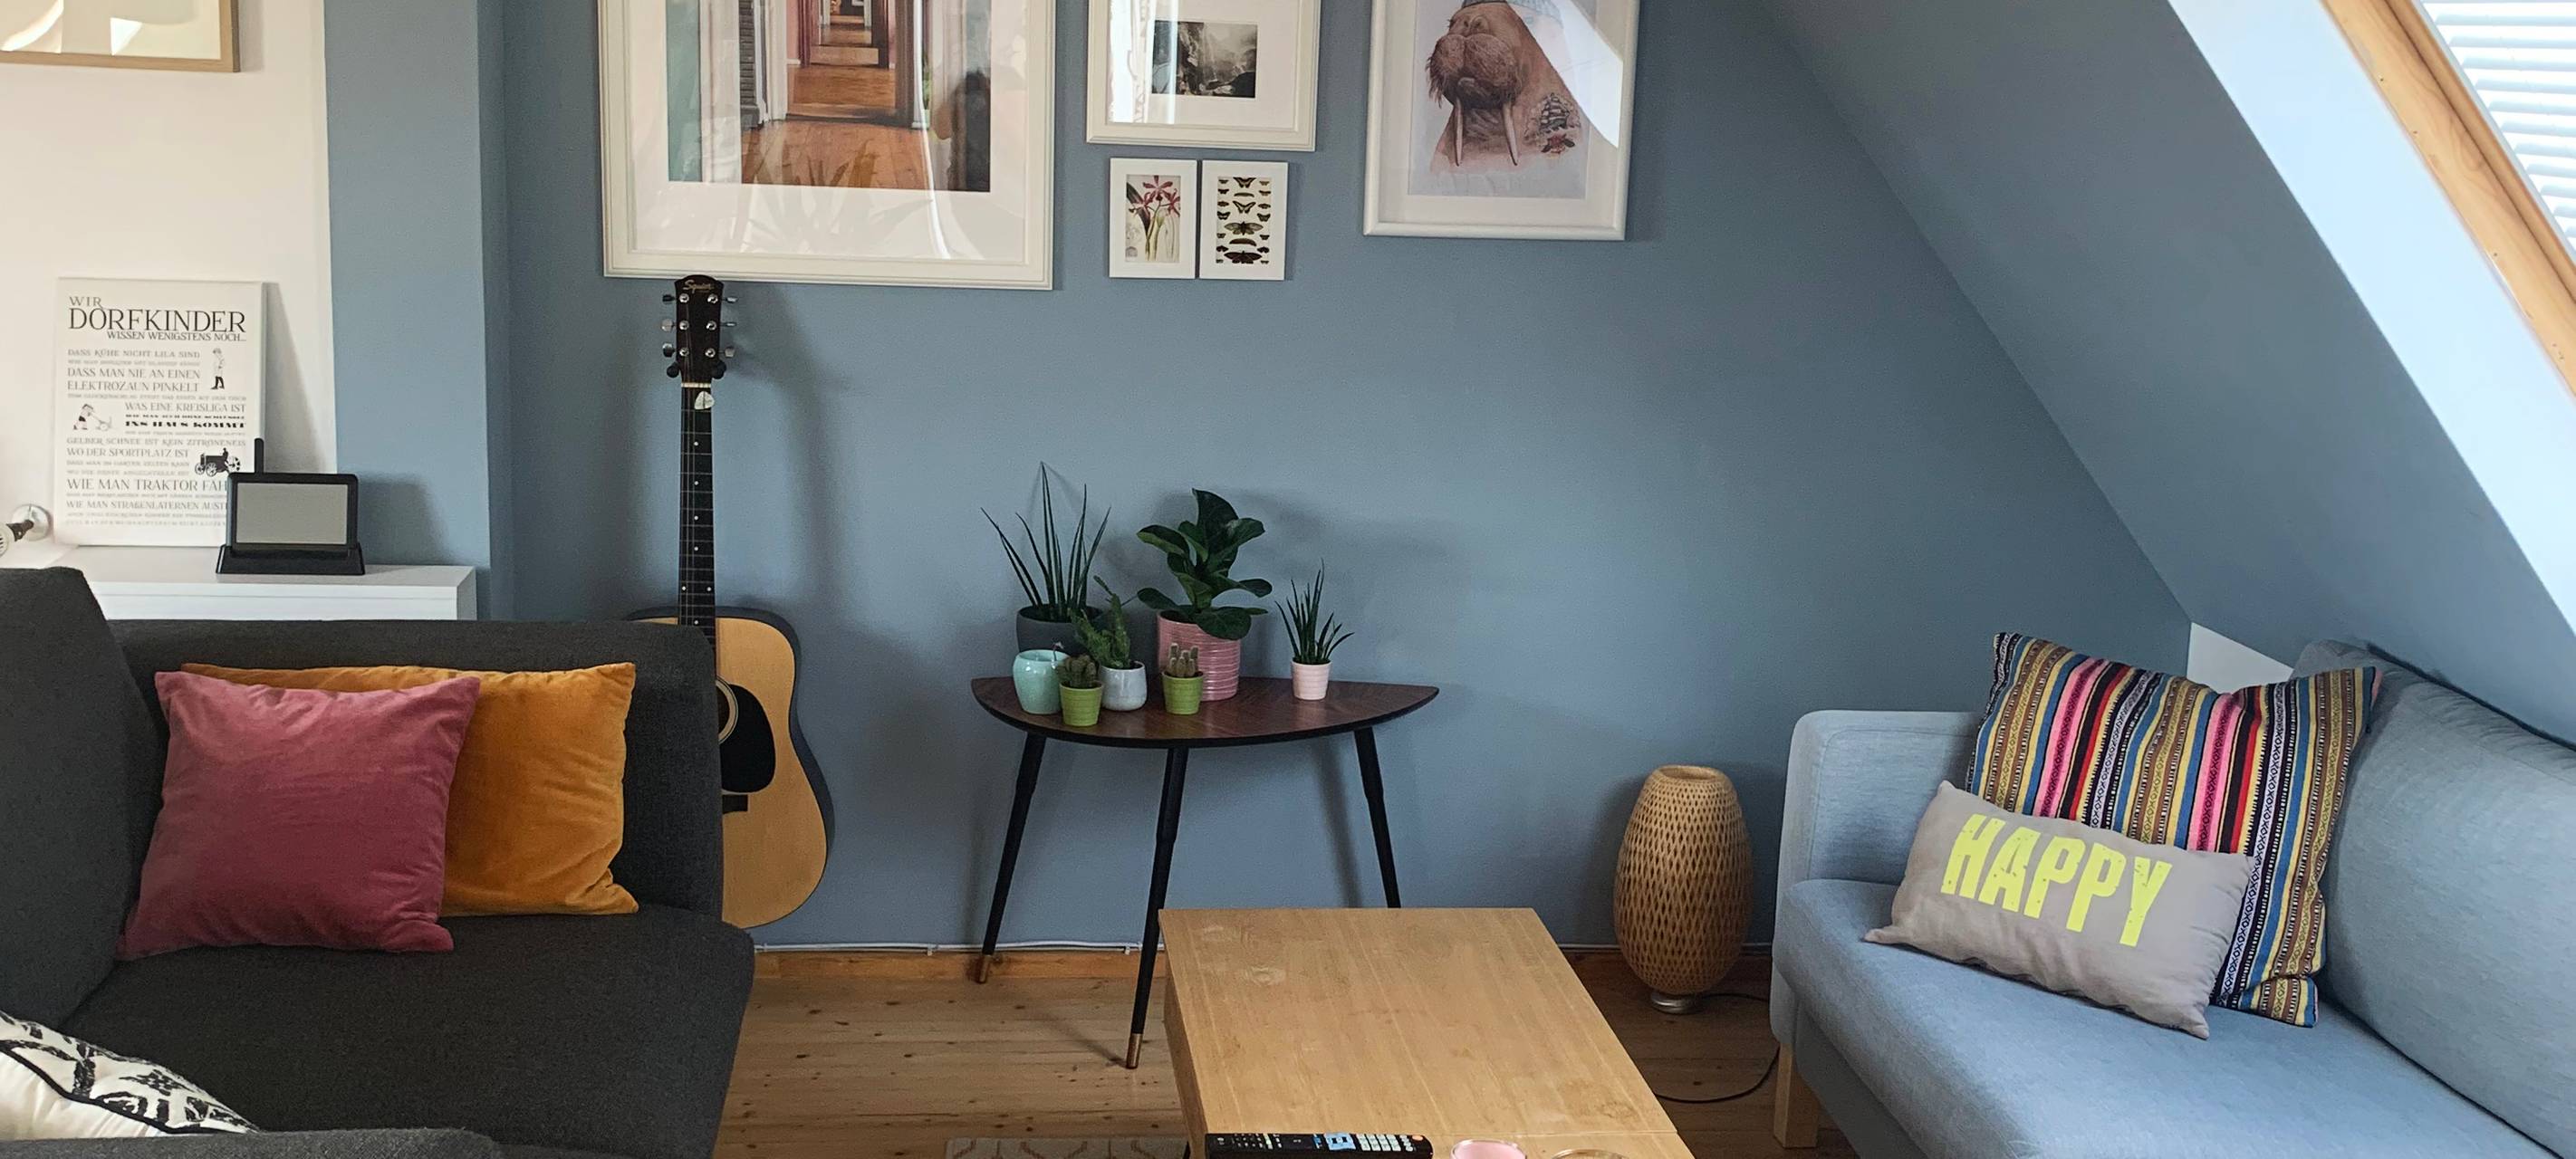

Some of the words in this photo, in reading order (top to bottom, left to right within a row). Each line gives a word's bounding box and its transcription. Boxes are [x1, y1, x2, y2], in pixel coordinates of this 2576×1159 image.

[682, 279, 715, 294] Squier
[69, 296, 103, 308] WIR
[68, 308, 246, 332] DORFKINDER
[107, 331, 145, 340] WISSEN
[148, 331, 211, 341] WENIGSTENS
[67, 368, 96, 377] DASS
[99, 368, 125, 377] MAN
[128, 369, 147, 378] NIE
[149, 369, 165, 378] AN
[168, 369, 200, 378] EINEN
[67, 380, 149, 391] ELEKTROZAUN
[152, 382, 199, 392] PINKELT
[124, 402, 148, 410] WAS
[150, 402, 171, 411] EINE
[176, 403, 228, 412] KREISLIGA
[231, 404, 247, 412] IST
[66, 447, 84, 455] WO
[86, 448, 106, 456] DER
[109, 448, 172, 457] SPORTPLATZ
[175, 449, 188, 457] IST
[66, 478, 94, 490] WIE
[99, 478, 130, 490] MAN
[132, 479, 197, 491] TRAKTOR
[201, 480, 227, 491] FAH
[66, 500, 84, 508] WIE
[88, 500, 109, 508] MAN
[1940, 813, 2173, 947] HAPPY
